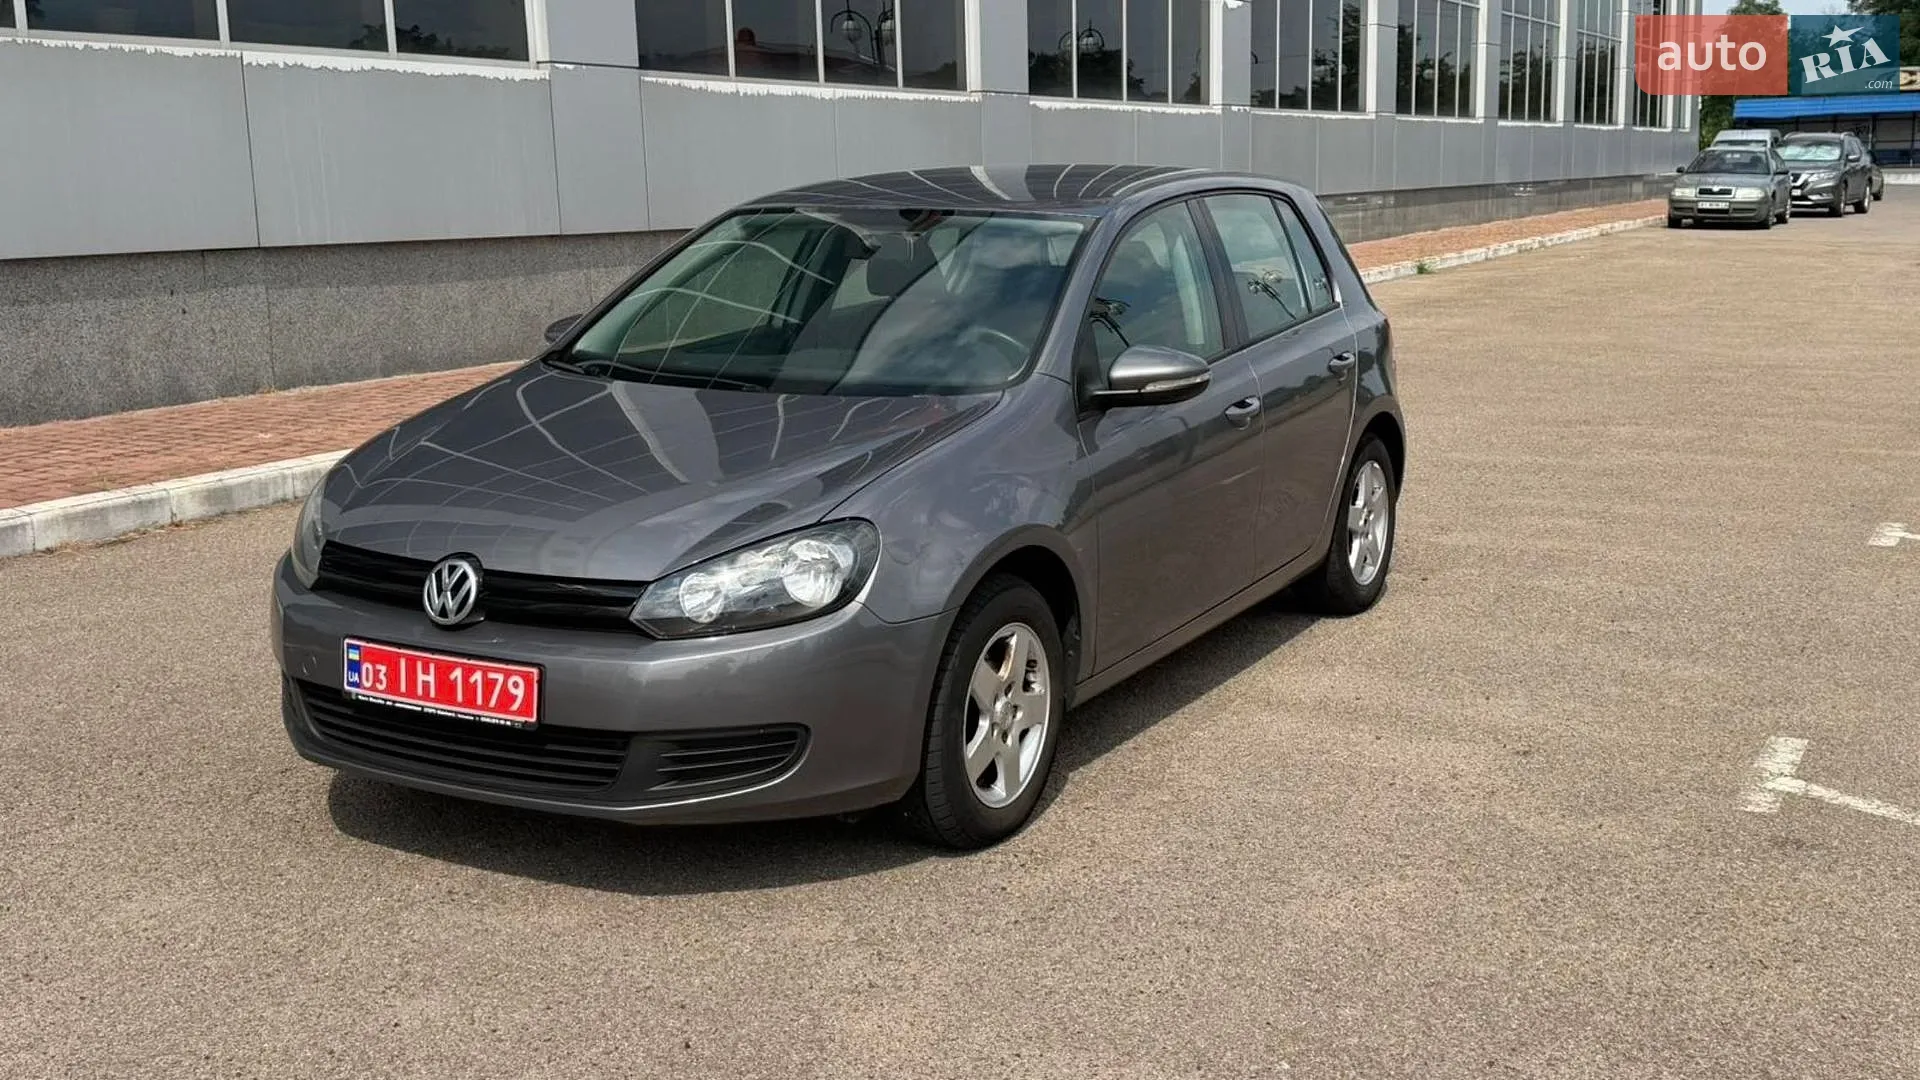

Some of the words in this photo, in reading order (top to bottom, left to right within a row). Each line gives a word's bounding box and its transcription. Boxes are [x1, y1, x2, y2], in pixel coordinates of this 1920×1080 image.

[348, 672, 360, 683] UA
[361, 662, 387, 691] 03
[449, 666, 525, 712] 1179
